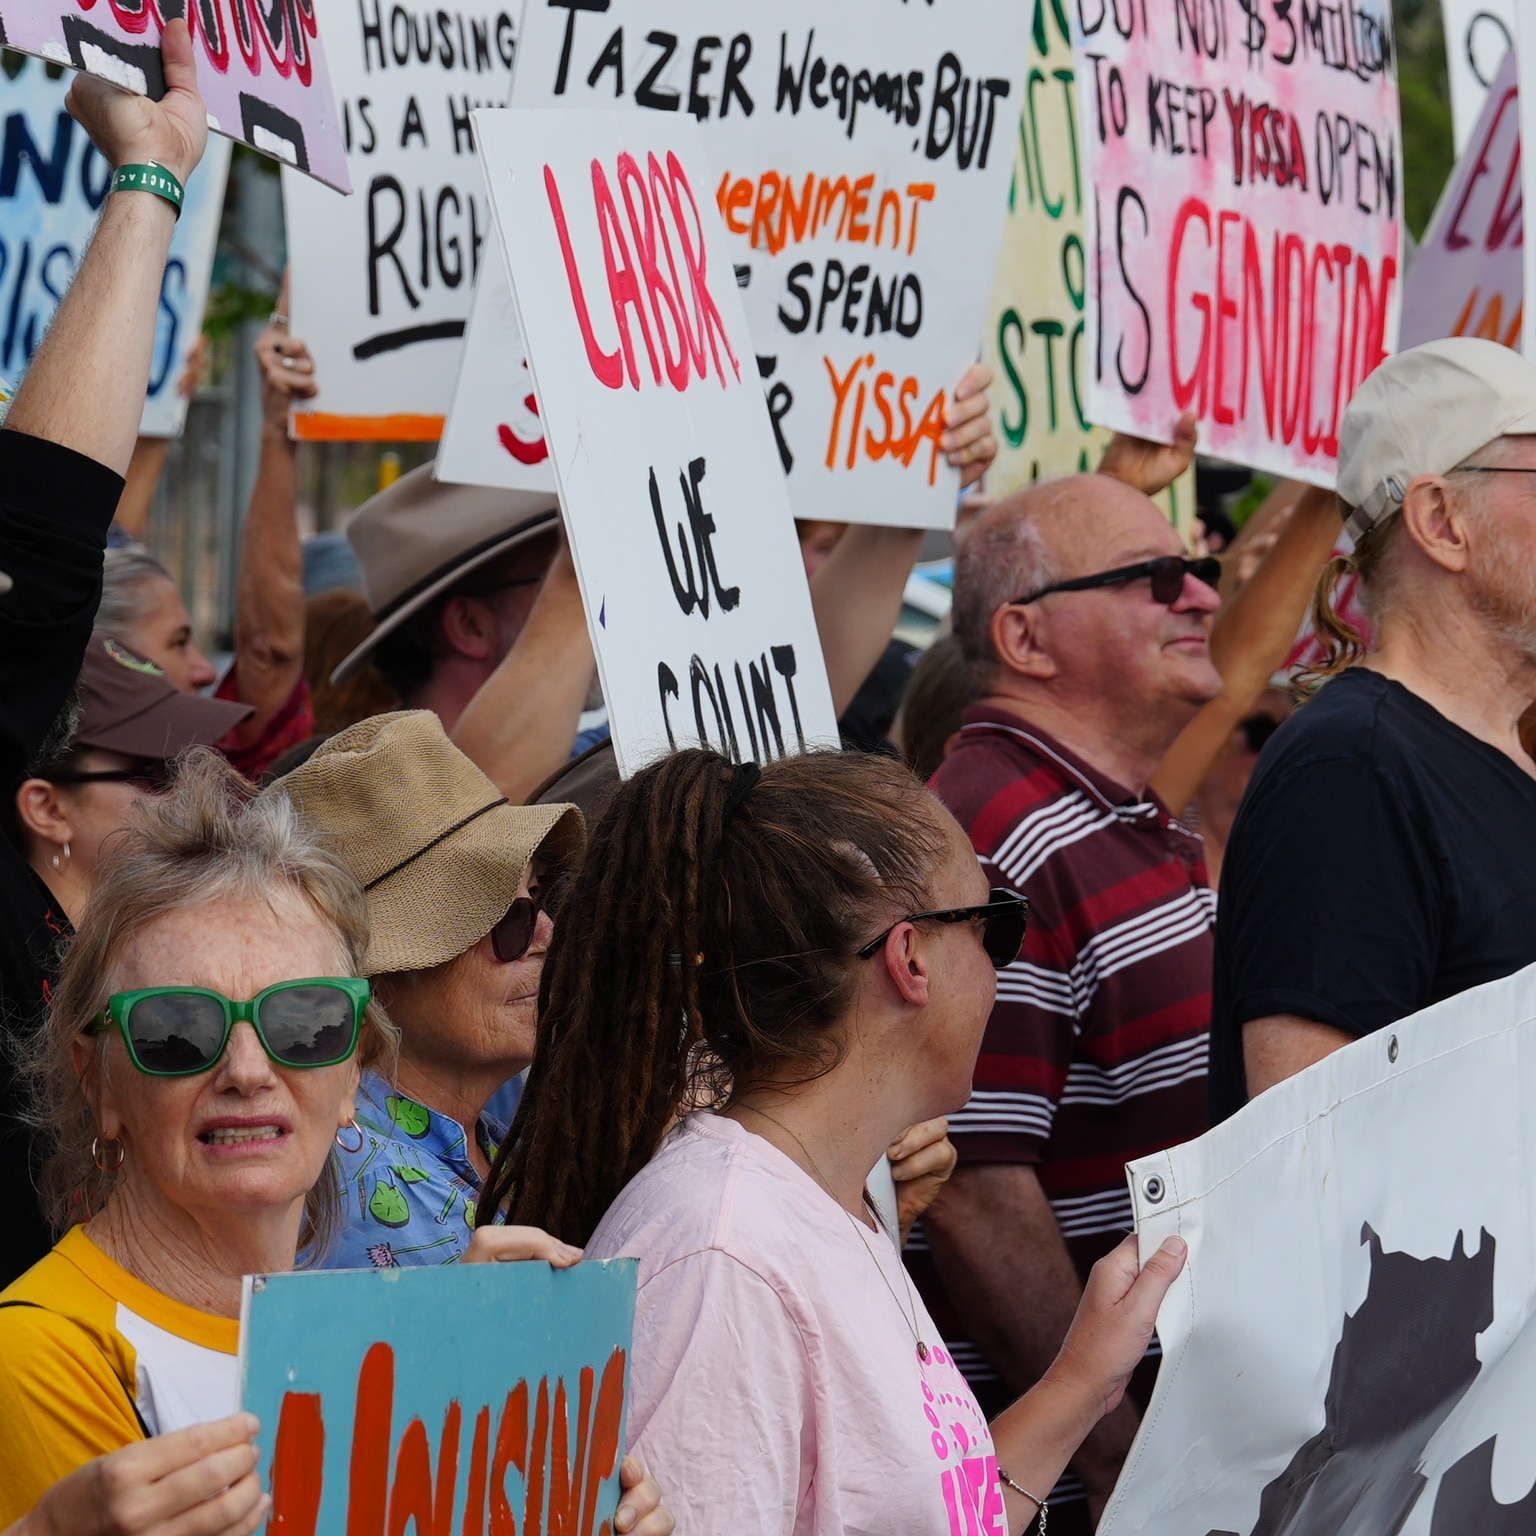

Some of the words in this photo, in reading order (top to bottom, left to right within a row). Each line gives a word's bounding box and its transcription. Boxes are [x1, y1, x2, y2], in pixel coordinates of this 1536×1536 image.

[343, 96, 376, 155] IS
[401, 94, 428, 149] A
[925, 51, 1011, 171] BUT
[1081, 53, 1128, 144] TO
[1146, 75, 1216, 159] KEEP
[1223, 88, 1308, 192] YISSA
[1314, 109, 1395, 219] OPEN
[543, 149, 741, 392] LABOR
[778, 259, 924, 339] SPEND
[1089, 184, 1155, 397] IS
[1165, 195, 1398, 461] GENOCIDE
[649, 456, 740, 621] WE
[658, 644, 806, 766] COUNT
